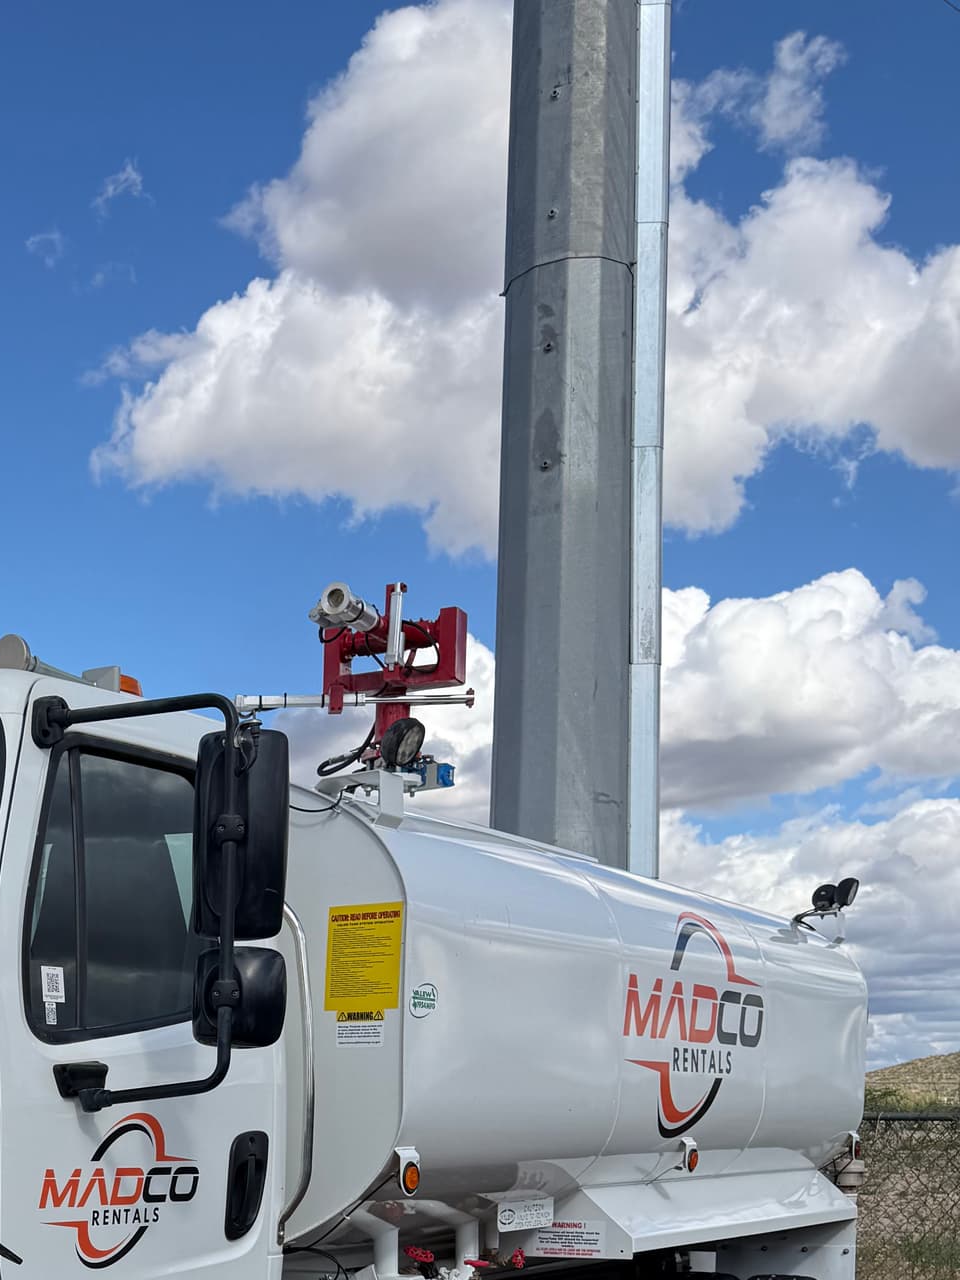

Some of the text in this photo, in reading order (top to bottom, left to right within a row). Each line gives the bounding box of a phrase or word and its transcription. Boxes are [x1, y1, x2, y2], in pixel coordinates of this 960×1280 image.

[347, 1012, 373, 1020] WARNING
[623, 973, 764, 1048] MADCO
[672, 1047, 732, 1075] RENTALS
[38, 1166, 200, 1209] MADCO
[91, 1207, 160, 1226] RENTALS
